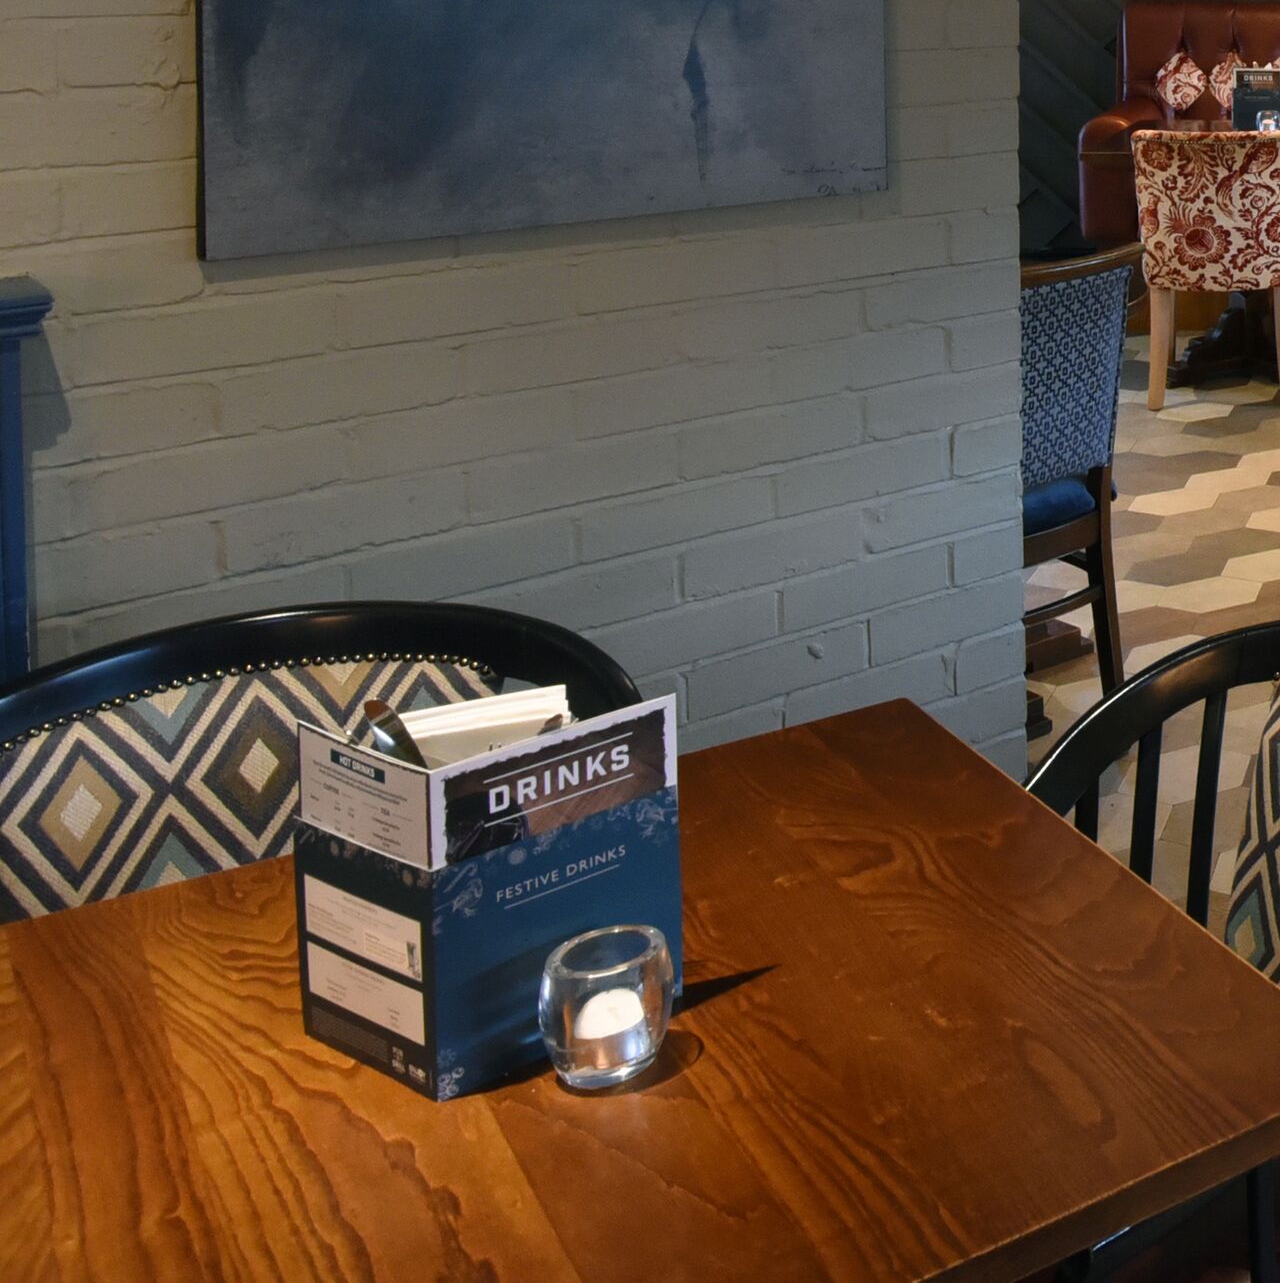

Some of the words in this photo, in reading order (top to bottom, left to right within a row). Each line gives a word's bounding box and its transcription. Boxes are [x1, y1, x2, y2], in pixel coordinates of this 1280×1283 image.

[339, 754, 352, 768] HOT
[352, 760, 375, 778] DRINKS
[489, 744, 630, 814] DRINKS
[496, 869, 560, 902] FESTIVE
[566, 845, 627, 877] DRINKS
